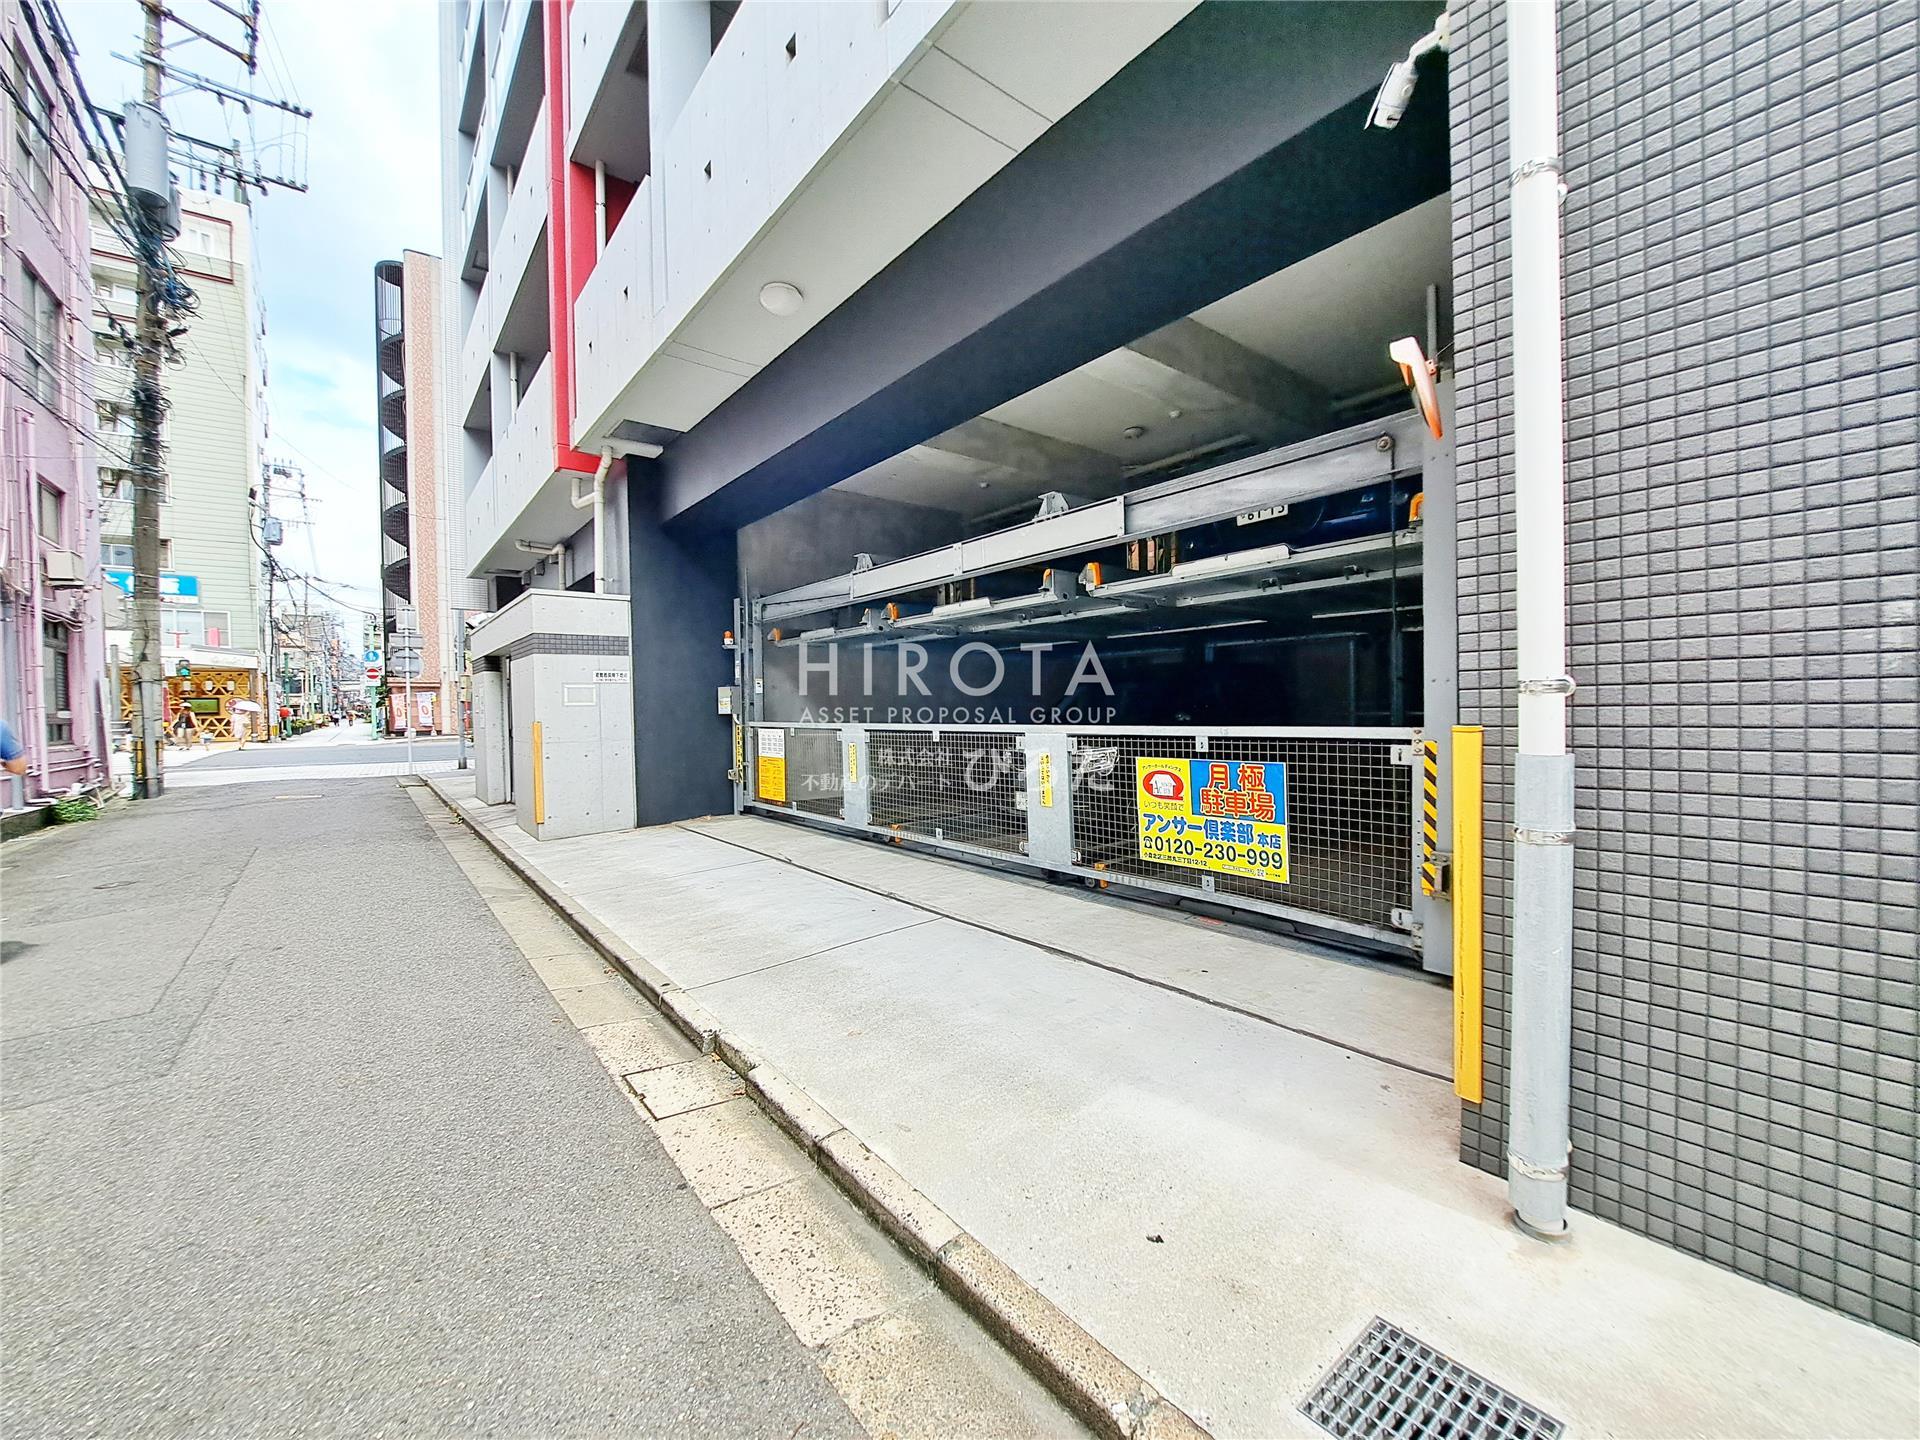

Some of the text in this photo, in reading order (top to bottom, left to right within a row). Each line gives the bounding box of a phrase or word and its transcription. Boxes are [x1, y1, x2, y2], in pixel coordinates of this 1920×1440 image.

[1208, 764, 1265, 792] 月極
[1143, 800, 1185, 812] いつも笑顔で
[1201, 789, 1275, 822] 駐車場
[1143, 813, 1282, 850] アンサー倶楽部 本店
[1154, 836, 1283, 869] 0120-230-999
